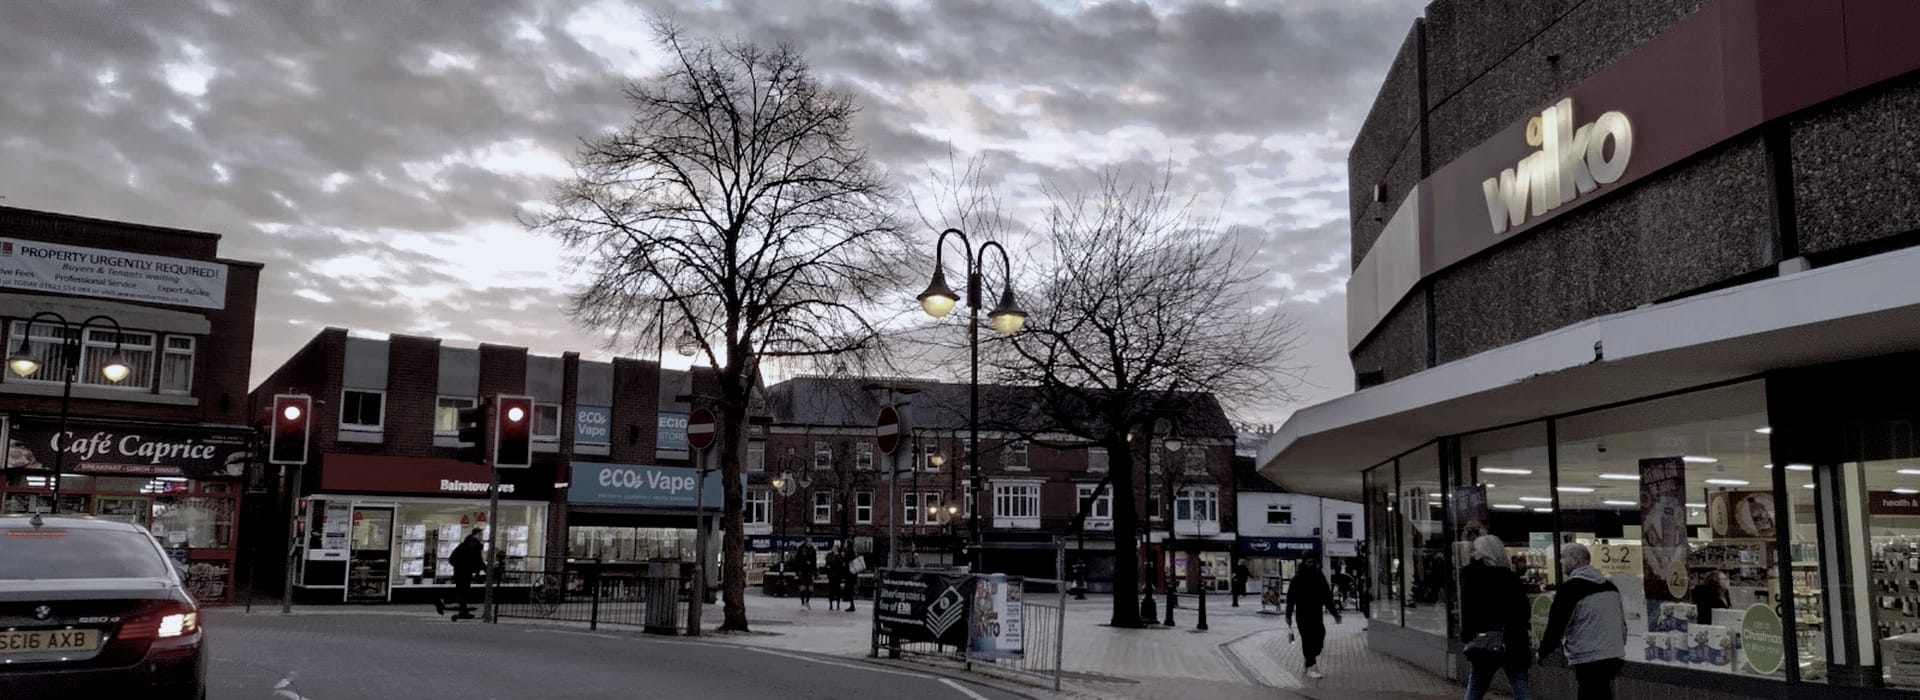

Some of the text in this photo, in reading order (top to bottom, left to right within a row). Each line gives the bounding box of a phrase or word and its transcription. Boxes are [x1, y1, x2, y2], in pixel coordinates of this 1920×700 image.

[1482, 97, 1633, 234] wilko
[21, 246, 219, 279] PROPERTY URGENTLY REQUIRED!
[15, 269, 34, 277] Fees
[62, 263, 94, 273] Buyers
[107, 268, 143, 279] Tenants
[145, 273, 180, 284] waiting
[54, 273, 137, 288] Professional Service
[157, 284, 210, 297] Expert Advice
[578, 411, 601, 424] eco
[658, 417, 687, 429] ECIG
[578, 424, 607, 438] Vape
[658, 431, 687, 441] STORE
[50, 431, 216, 464] Café Caprice
[440, 479, 490, 492] Bairstow
[599, 468, 695, 495] eco Vape
[1882, 497, 1919, 507] health &
[1601, 546, 1631, 563] 3 2
[0, 631, 85, 650] SE16 AXB
